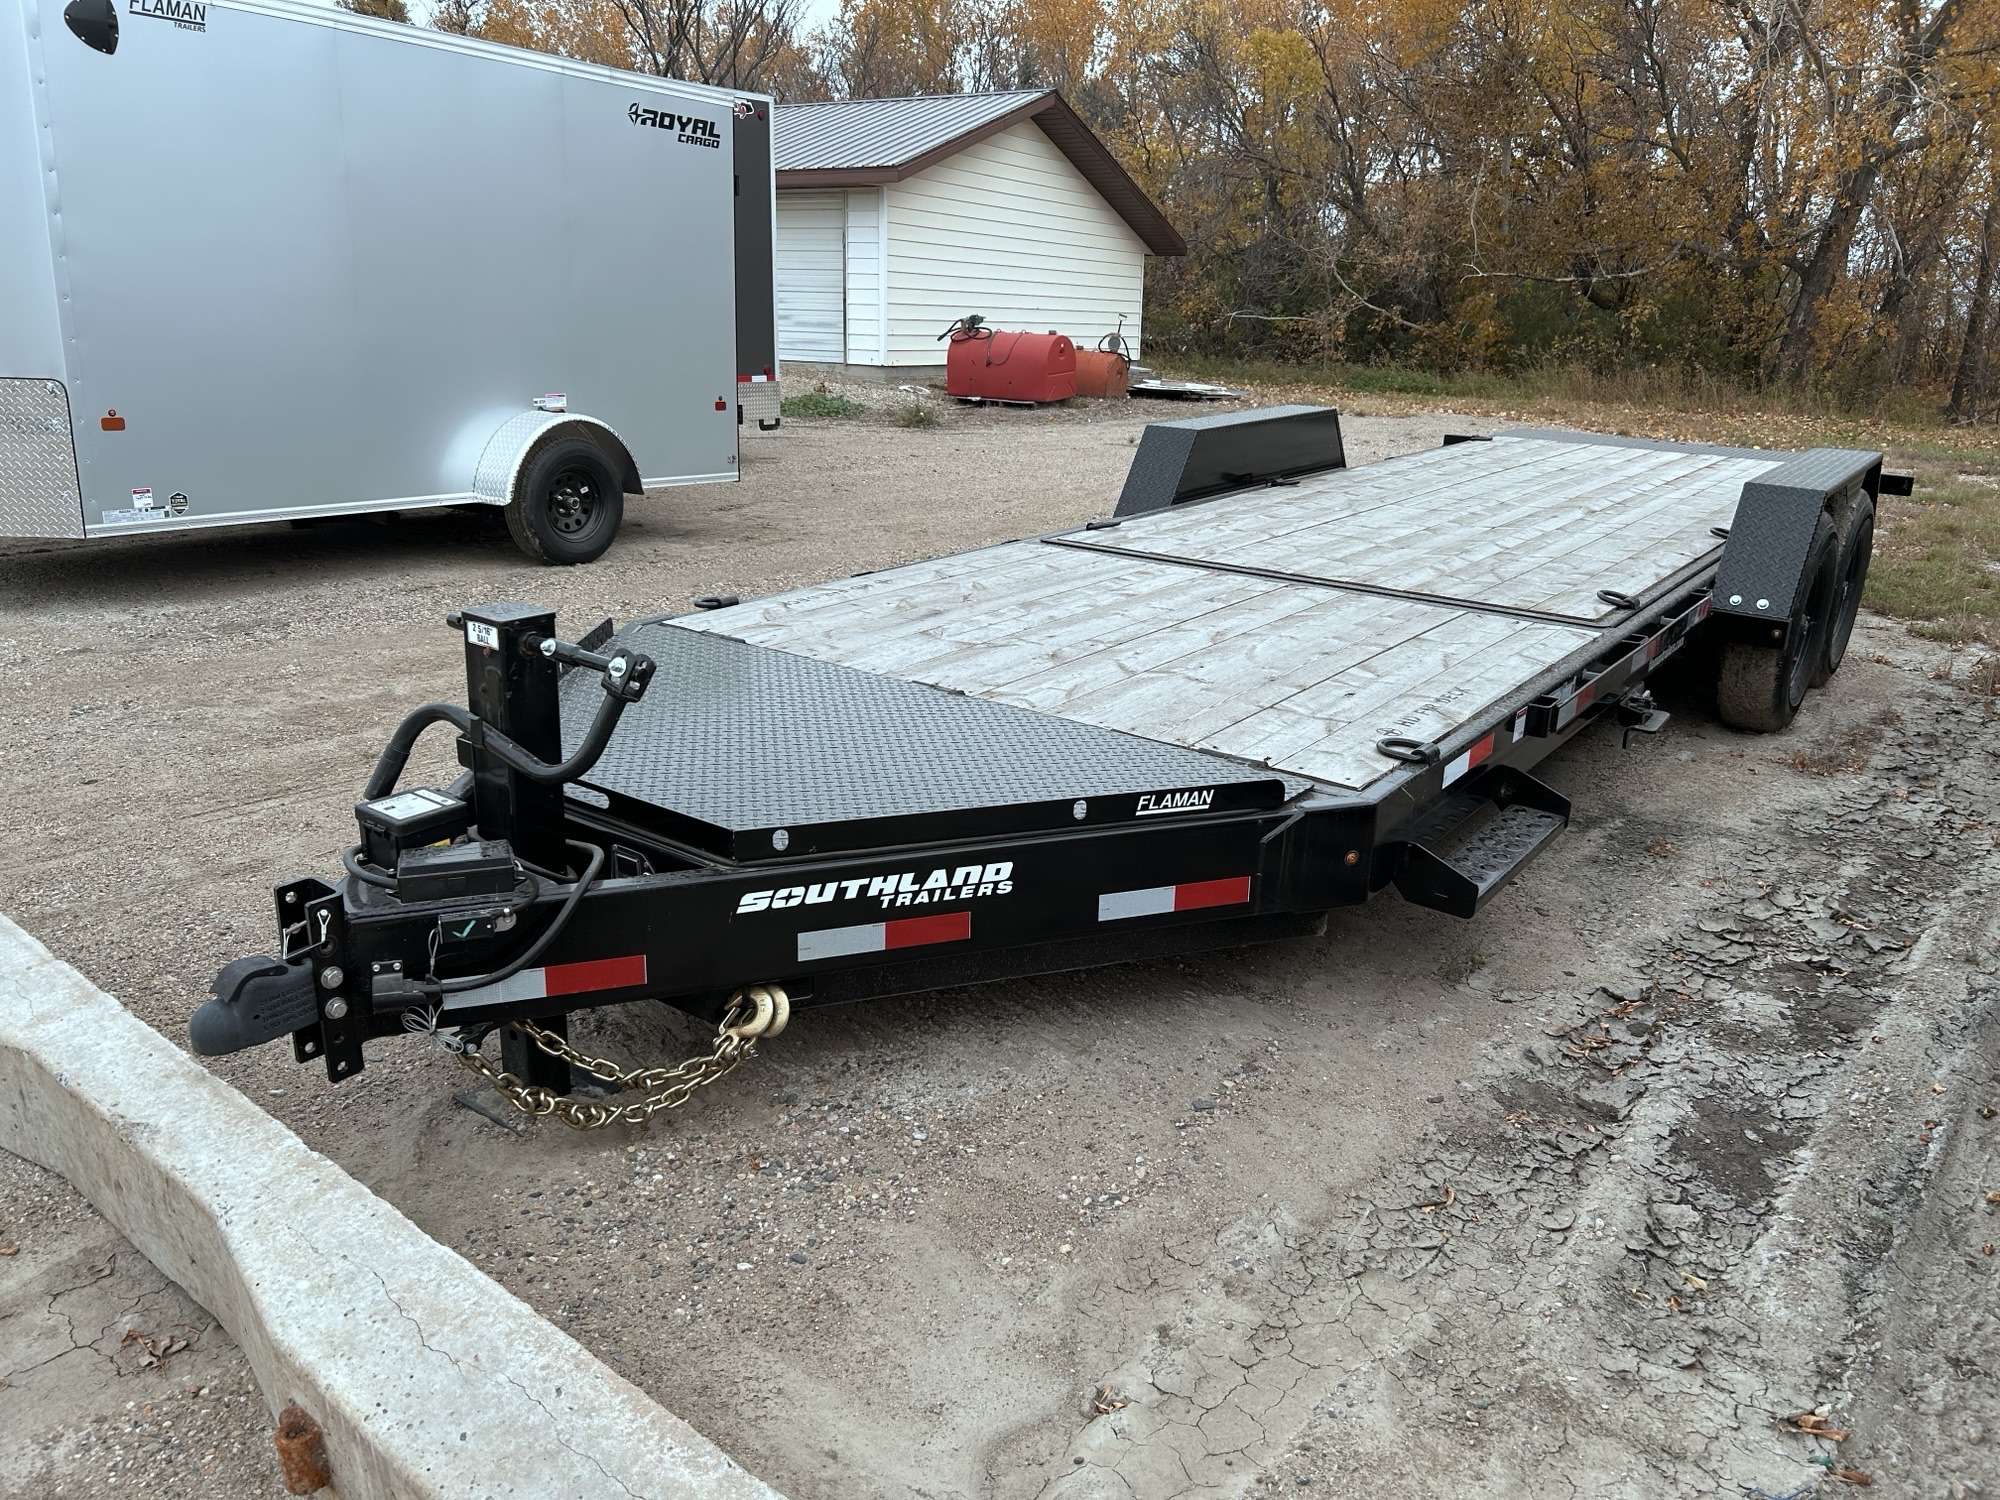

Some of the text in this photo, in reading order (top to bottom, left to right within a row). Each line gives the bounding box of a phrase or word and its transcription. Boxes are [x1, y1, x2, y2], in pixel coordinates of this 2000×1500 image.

[129, 0, 206, 22] FLAMAN
[173, 21, 206, 33] TRAILERS
[640, 108, 721, 139] ROYAL
[677, 133, 721, 149] CARGO
[472, 623, 477, 632] 2
[476, 634, 490, 645] BALL
[1136, 789, 1215, 811] FLAMAN
[735, 861, 1014, 914] SOUTHLAND
[879, 880, 1014, 909] TRAILERS
